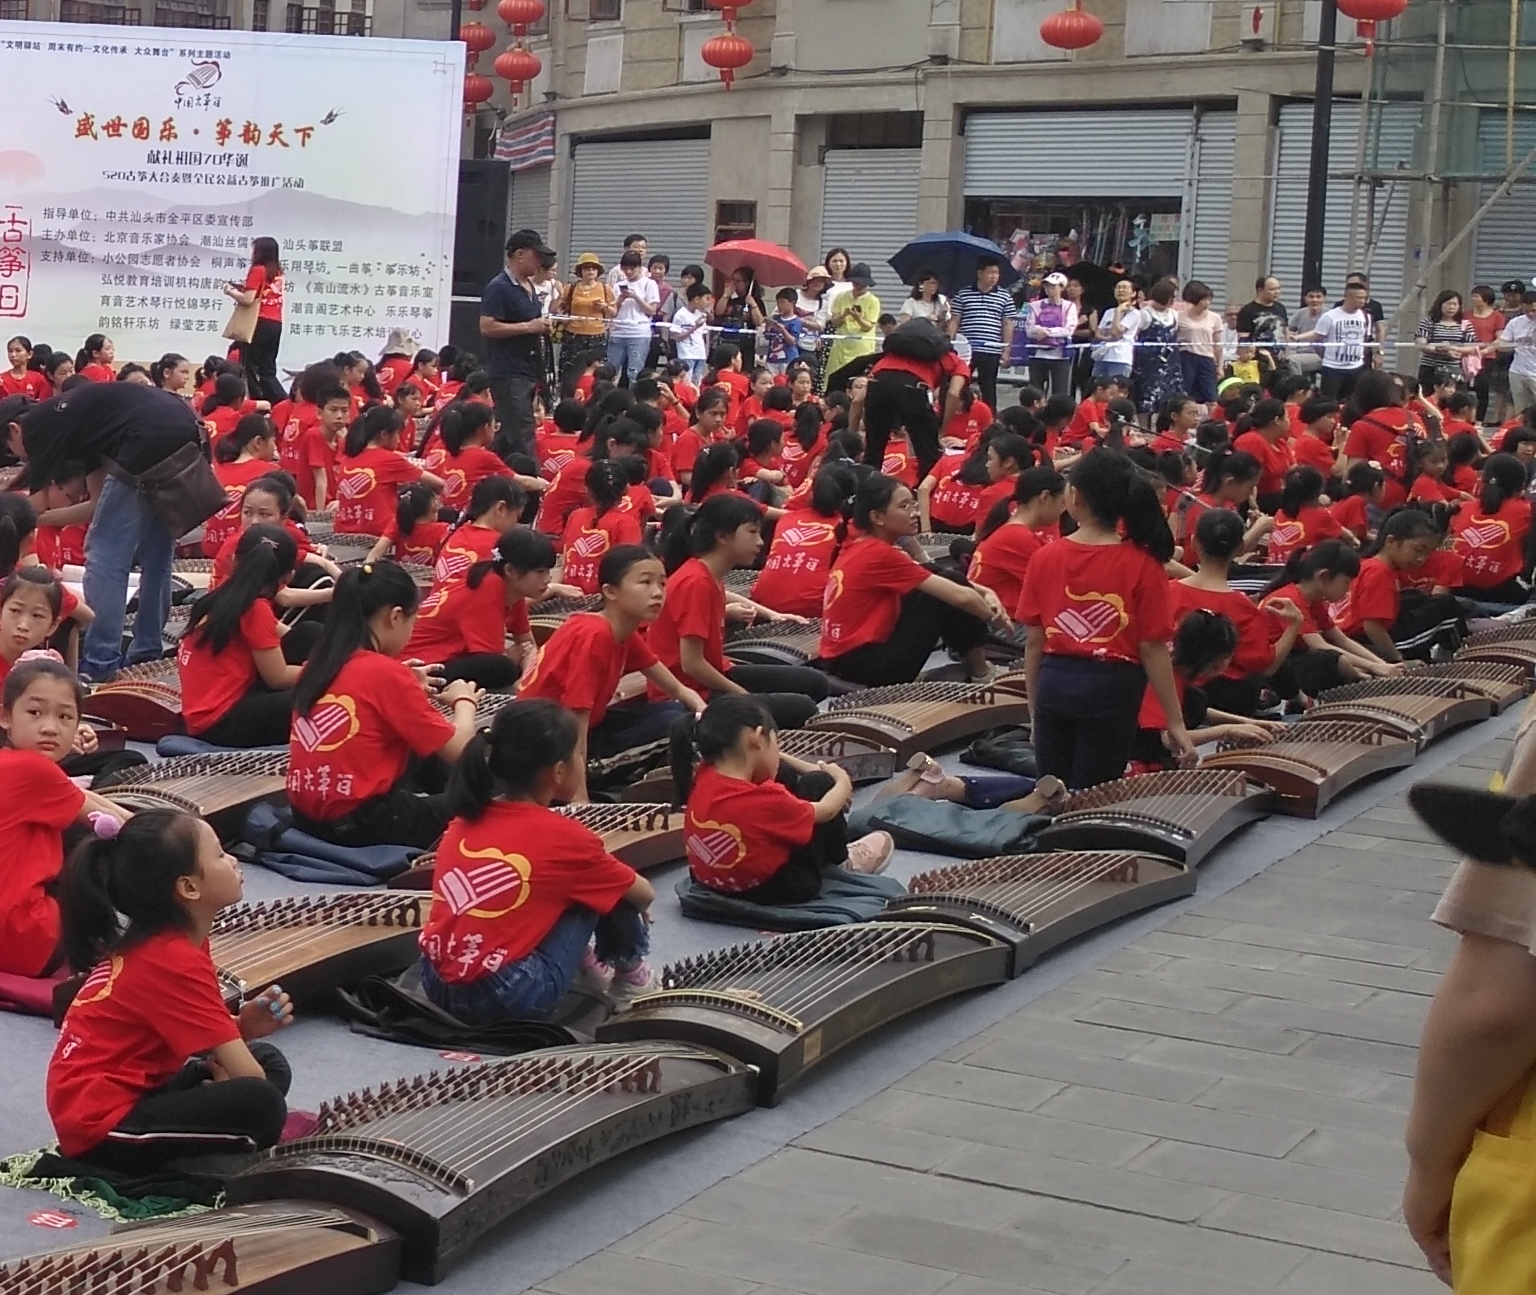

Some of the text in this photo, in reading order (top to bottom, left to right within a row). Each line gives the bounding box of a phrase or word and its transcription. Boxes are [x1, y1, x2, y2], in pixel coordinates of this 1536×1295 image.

[178, 48, 231, 59] 系列主题活动
[146, 149, 250, 168] 献礼祖国70华诞
[283, 239, 343, 252] 汕头筝联盟
[291, 302, 376, 317] 潮音阁艺术中心
[386, 306, 434, 319] 乐乐琴筝
